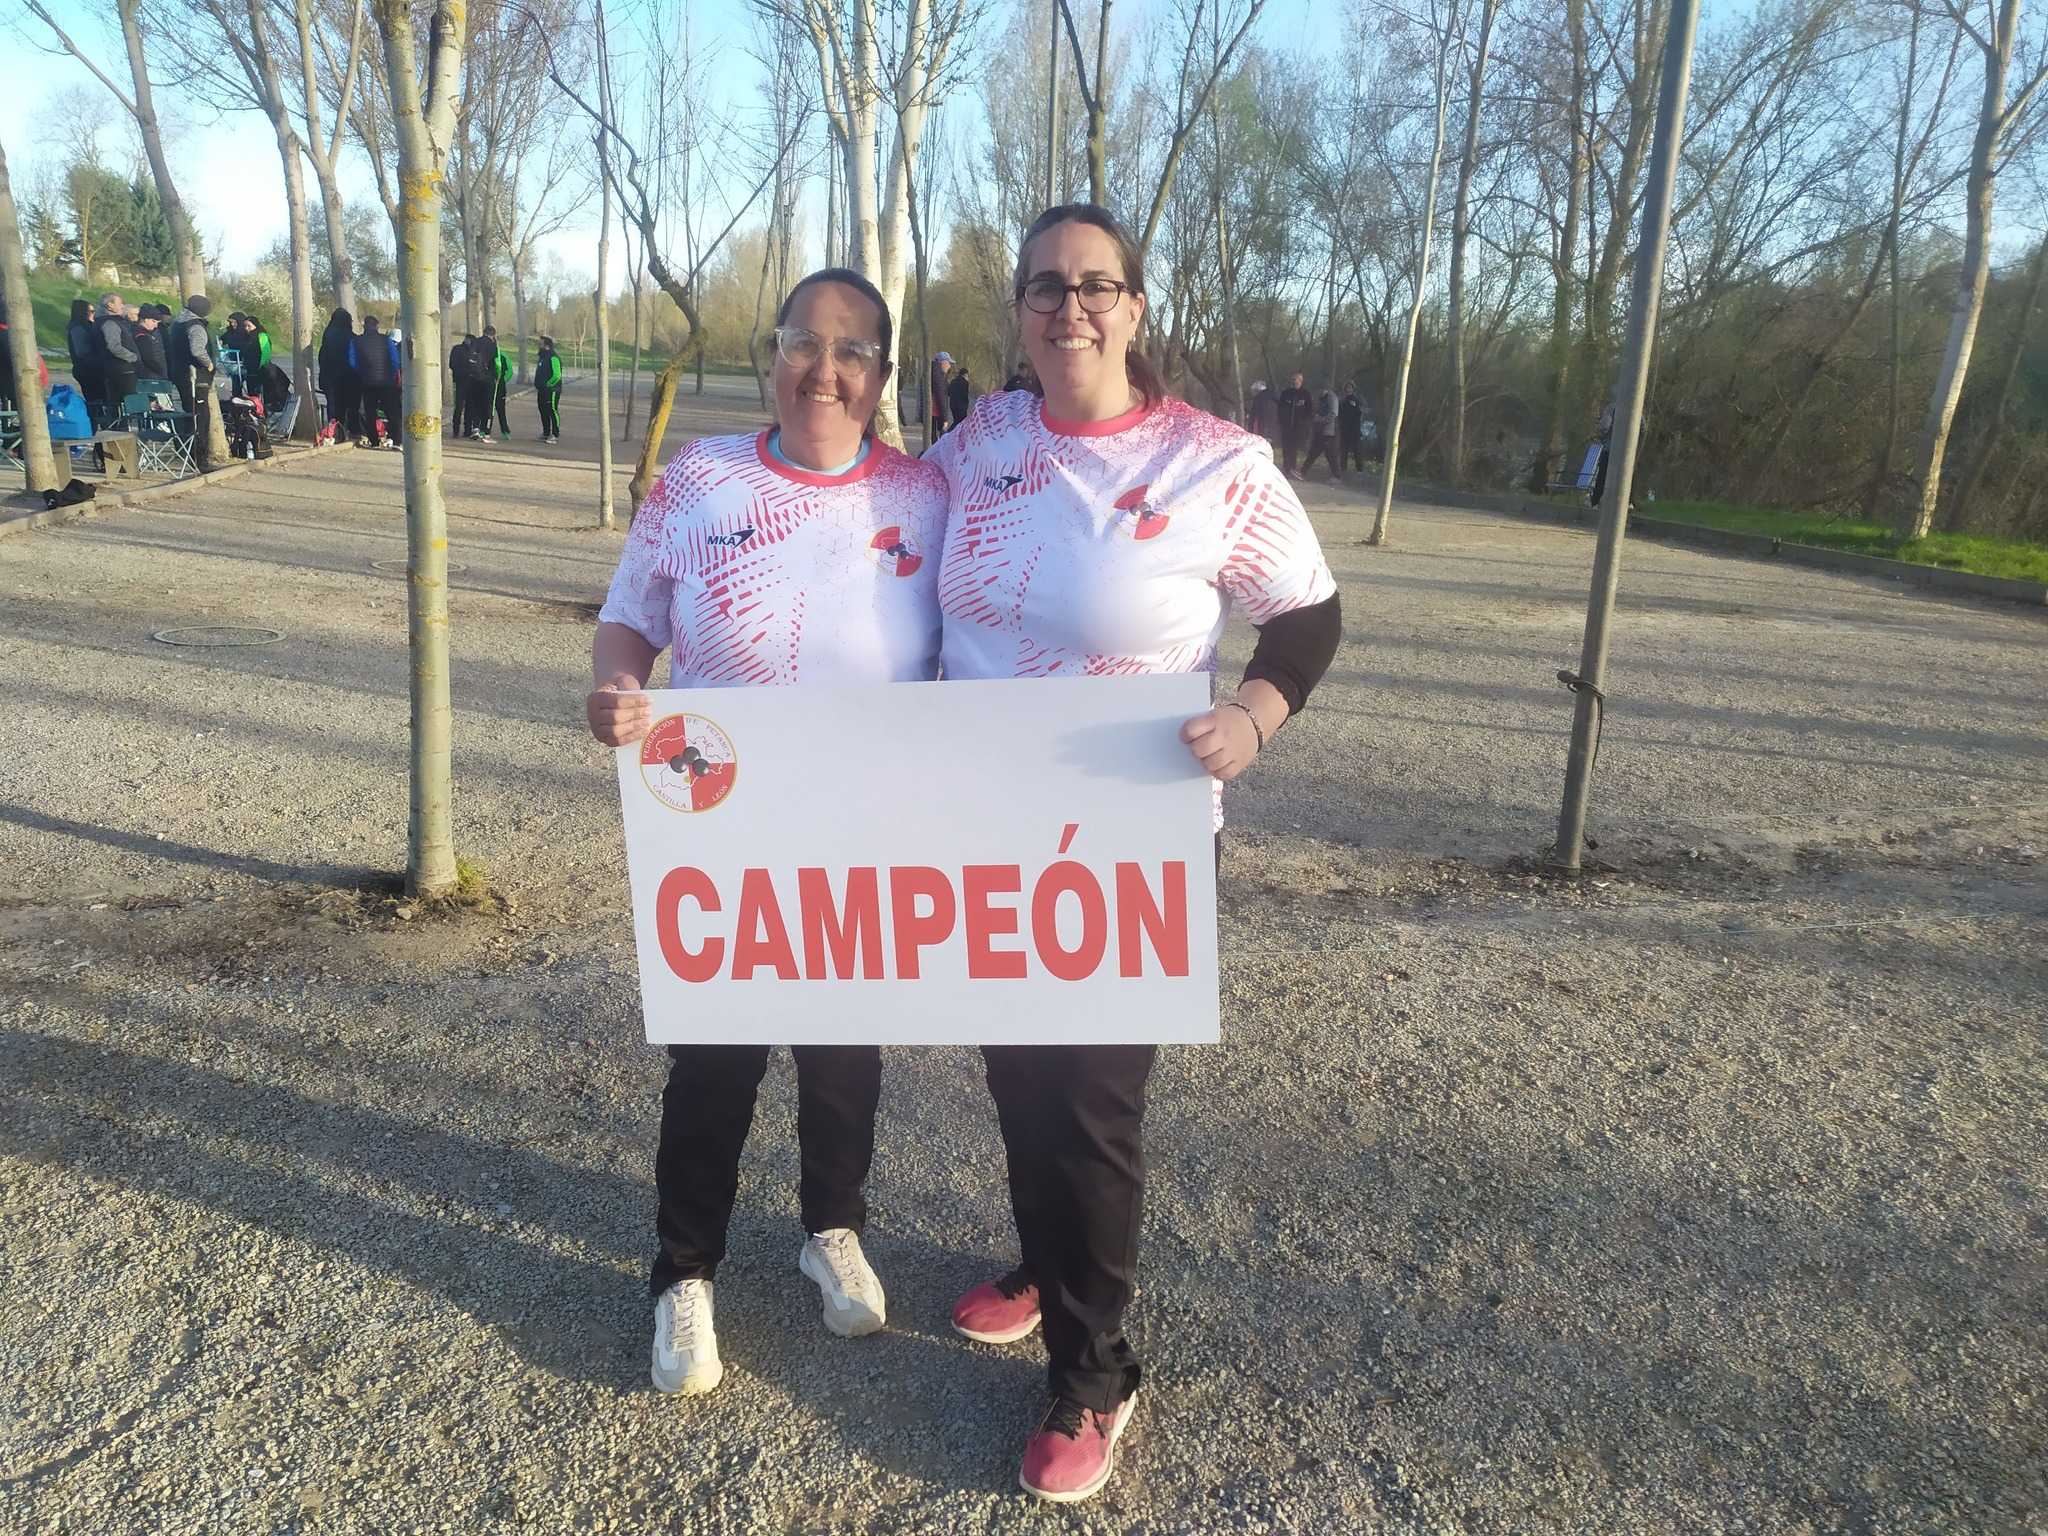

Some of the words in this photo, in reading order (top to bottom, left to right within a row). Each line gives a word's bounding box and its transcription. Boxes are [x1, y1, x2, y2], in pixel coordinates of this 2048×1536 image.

[984, 477, 1003, 491] MKA
[707, 535, 736, 546] MKA
[653, 784, 687, 809] CASTILLA
[656, 823, 1189, 982] CAMPEÓN
